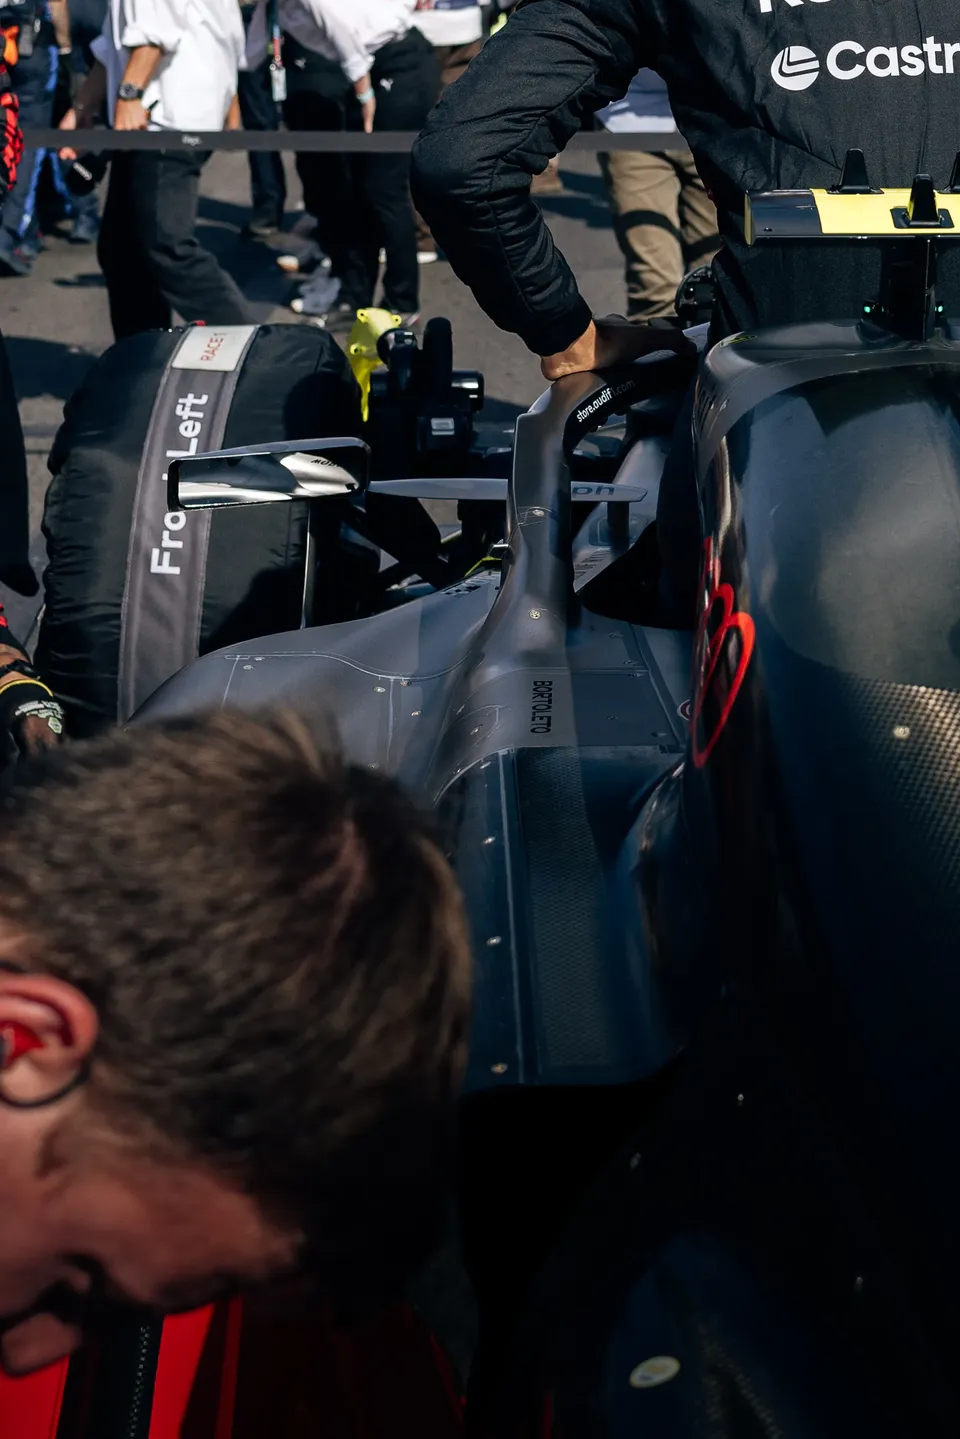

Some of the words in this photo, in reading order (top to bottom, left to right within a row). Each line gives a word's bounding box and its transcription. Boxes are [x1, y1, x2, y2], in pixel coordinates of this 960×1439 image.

[201, 338, 224, 361] RACE
[165, 392, 209, 457] Left
[577, 380, 636, 422] store.audif1.com
[150, 472, 187, 575] Fro
[531, 680, 553, 734] BORTOLETO
